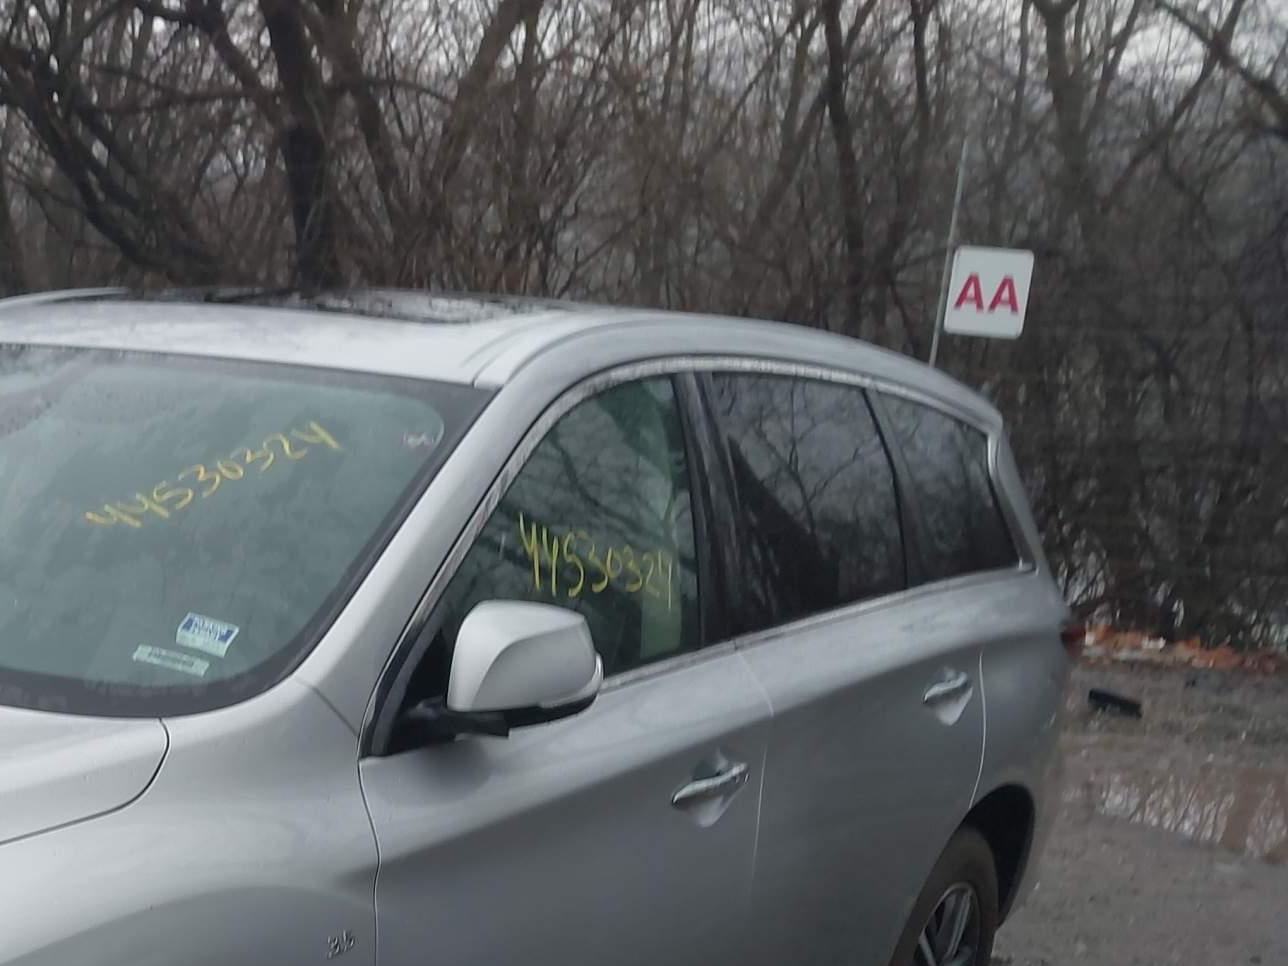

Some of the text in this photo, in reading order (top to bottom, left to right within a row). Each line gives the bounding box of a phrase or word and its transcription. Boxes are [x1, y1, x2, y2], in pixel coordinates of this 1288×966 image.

[954, 271, 1019, 315] AA
[85, 420, 342, 529] 44530324
[518, 511, 673, 612] 44530324
